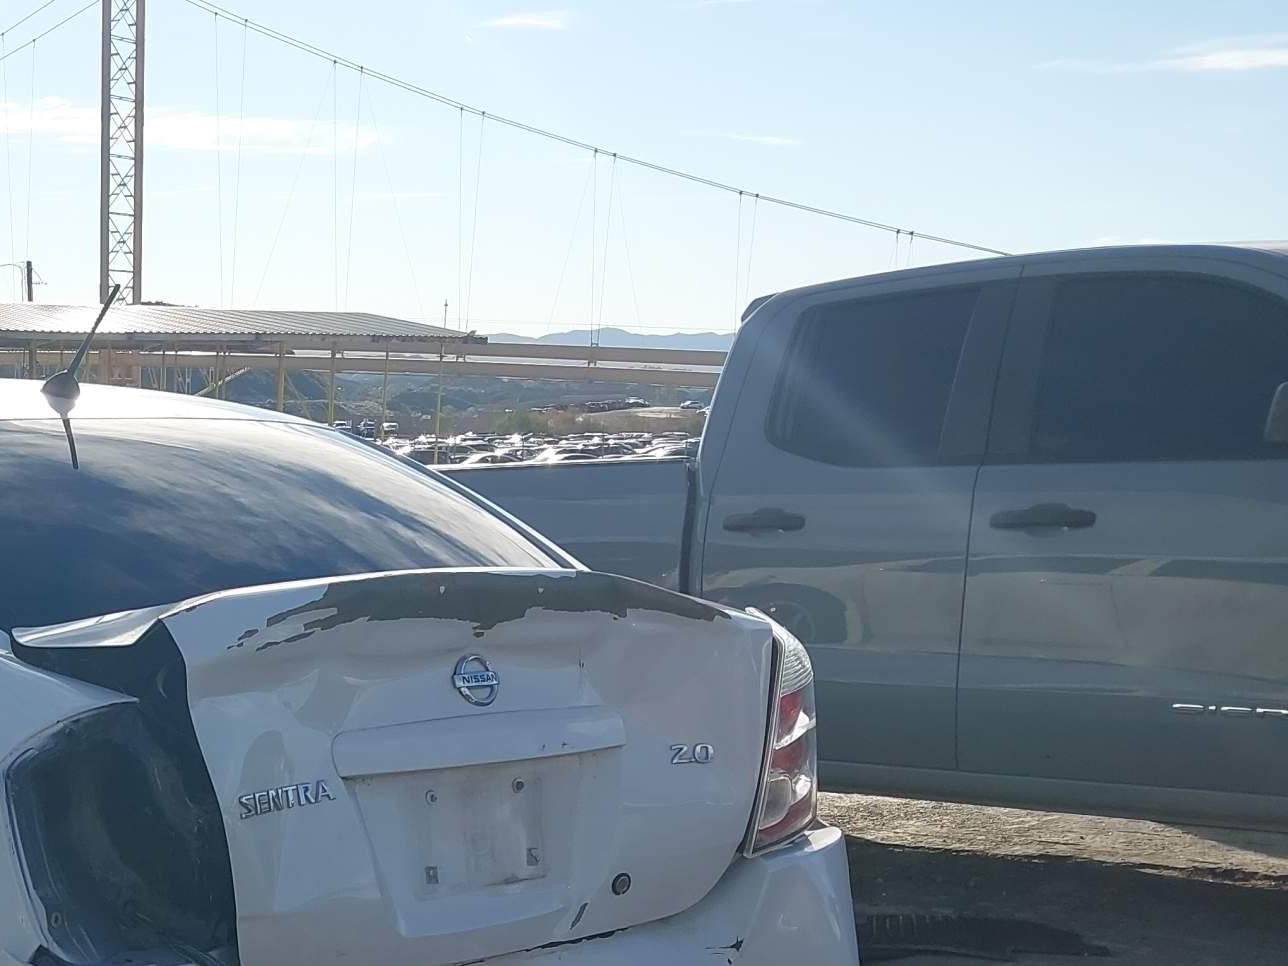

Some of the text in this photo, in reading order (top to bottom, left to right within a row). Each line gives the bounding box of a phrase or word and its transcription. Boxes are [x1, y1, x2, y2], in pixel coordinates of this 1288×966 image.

[462, 672, 497, 684] NISSAN
[670, 742, 715, 765] 2.0
[239, 779, 336, 820] SENTRA
